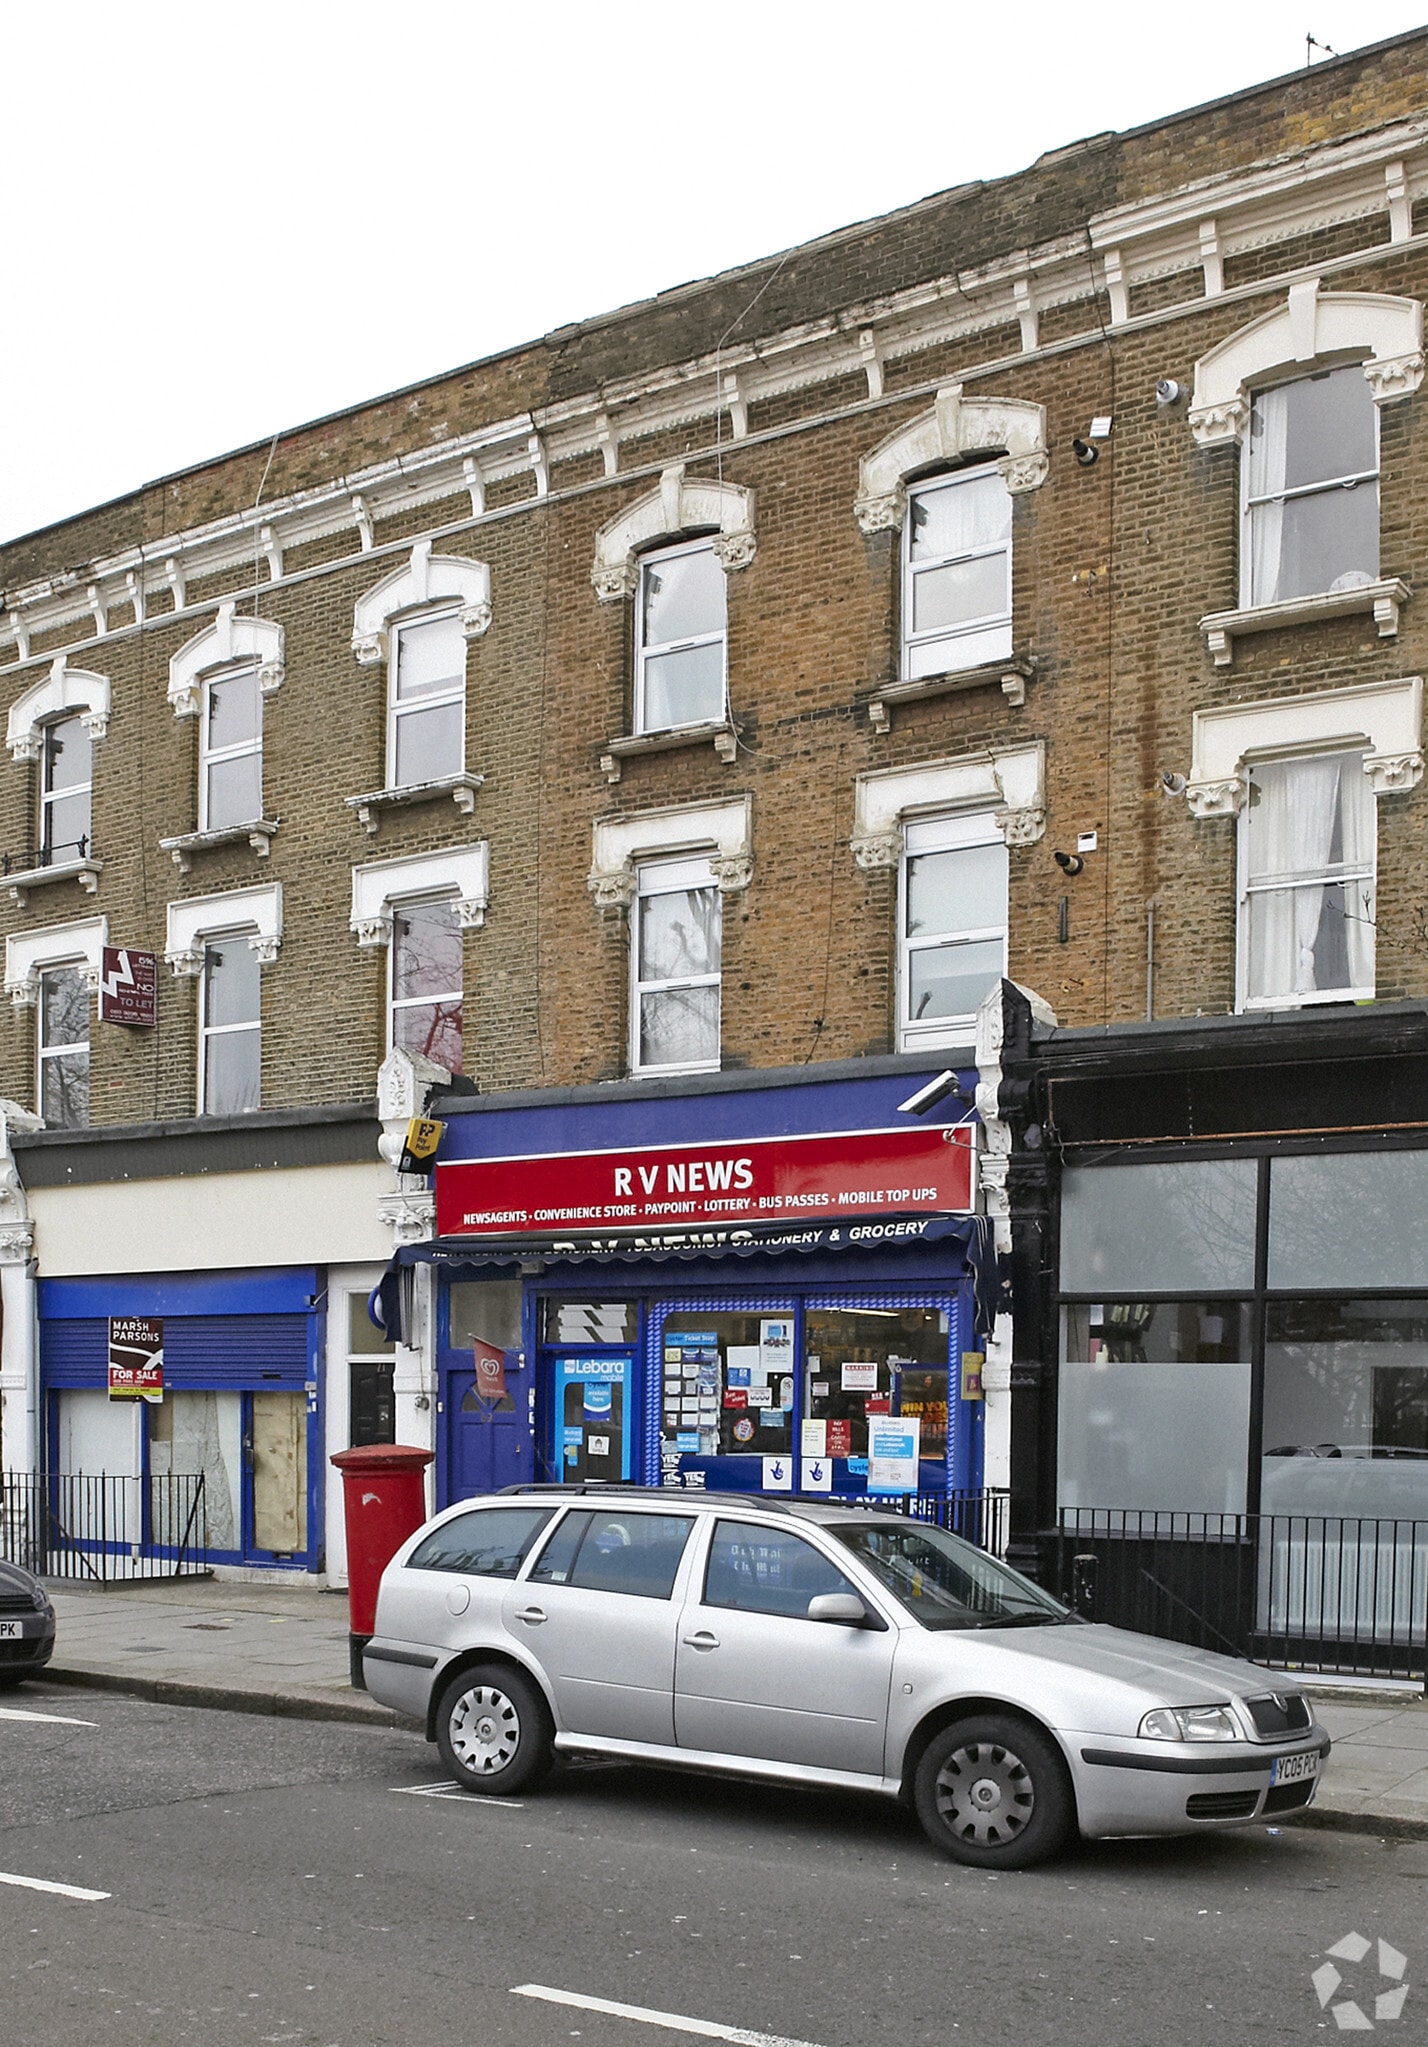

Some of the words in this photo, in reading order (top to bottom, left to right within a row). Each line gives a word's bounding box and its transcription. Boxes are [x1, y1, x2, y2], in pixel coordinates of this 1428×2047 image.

[136, 983, 154, 992] NO
[120, 997, 134, 1007] TO
[136, 1000, 153, 1009] LET
[614, 1168, 633, 1196] R
[638, 1165, 659, 1195] V
[667, 1158, 754, 1193] NEWS
[463, 1210, 527, 1225] NEWSAGENTS
[533, 1206, 602, 1221] CONVENIENCE
[603, 1204, 637, 1218] STORE
[645, 1200, 697, 1215] PAYPOINT
[704, 1197, 751, 1212] LOTTERY
[758, 1195, 783, 1209] BUS
[785, 1193, 829, 1207] PASSES
[838, 1190, 884, 1205] MOBILE
[886, 1189, 911, 1202] TOP
[912, 1187, 938, 1201] UPS
[829, 1229, 841, 1242] &
[849, 1220, 929, 1240] GROCERY
[112, 1321, 150, 1332] MARSH
[112, 1331, 160, 1342] PARSONS
[575, 1359, 625, 1374] Lebara
[112, 1369, 133, 1380] FOR
[136, 1371, 158, 1381] SALE
[600, 1374, 624, 1382] mobile
[873, 1426, 905, 1434] Unlimited
